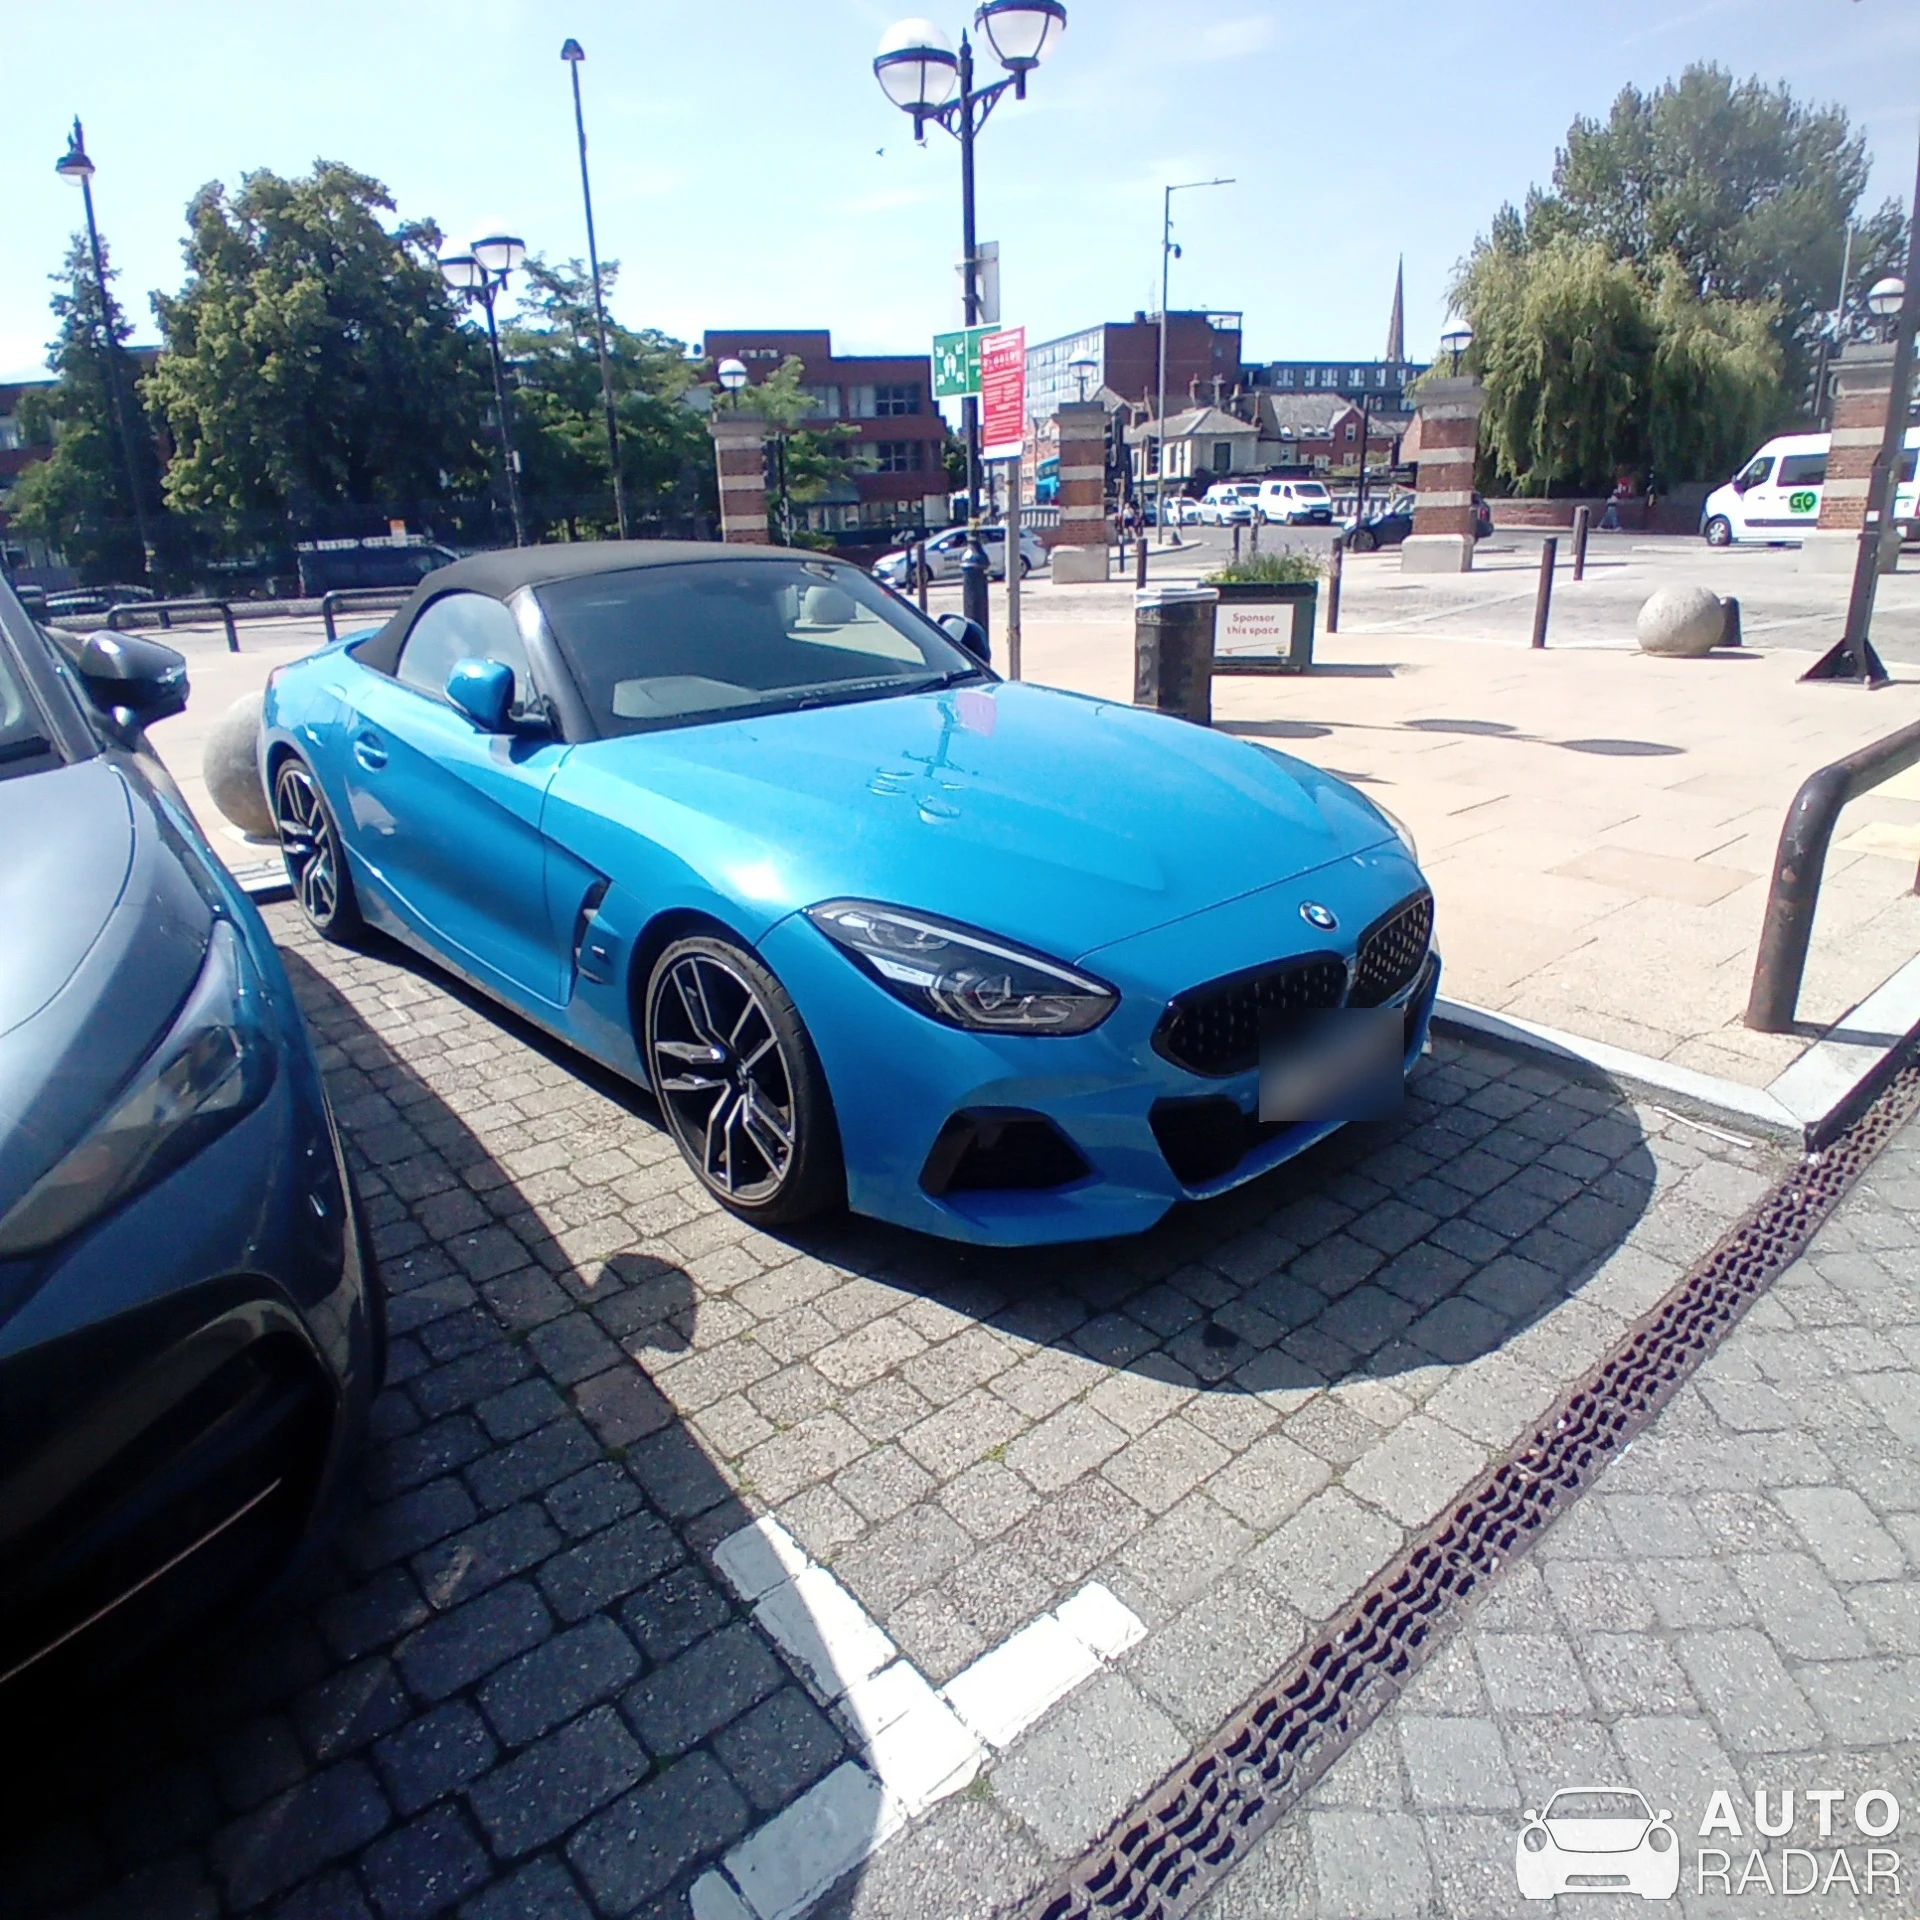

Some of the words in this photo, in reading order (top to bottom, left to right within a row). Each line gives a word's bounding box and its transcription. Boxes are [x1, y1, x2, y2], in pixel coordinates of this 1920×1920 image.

[1790, 492, 1817, 511] GO
[1232, 613, 1275, 623] Sponsor
[1226, 625, 1247, 635] this
[1249, 627, 1280, 637] space
